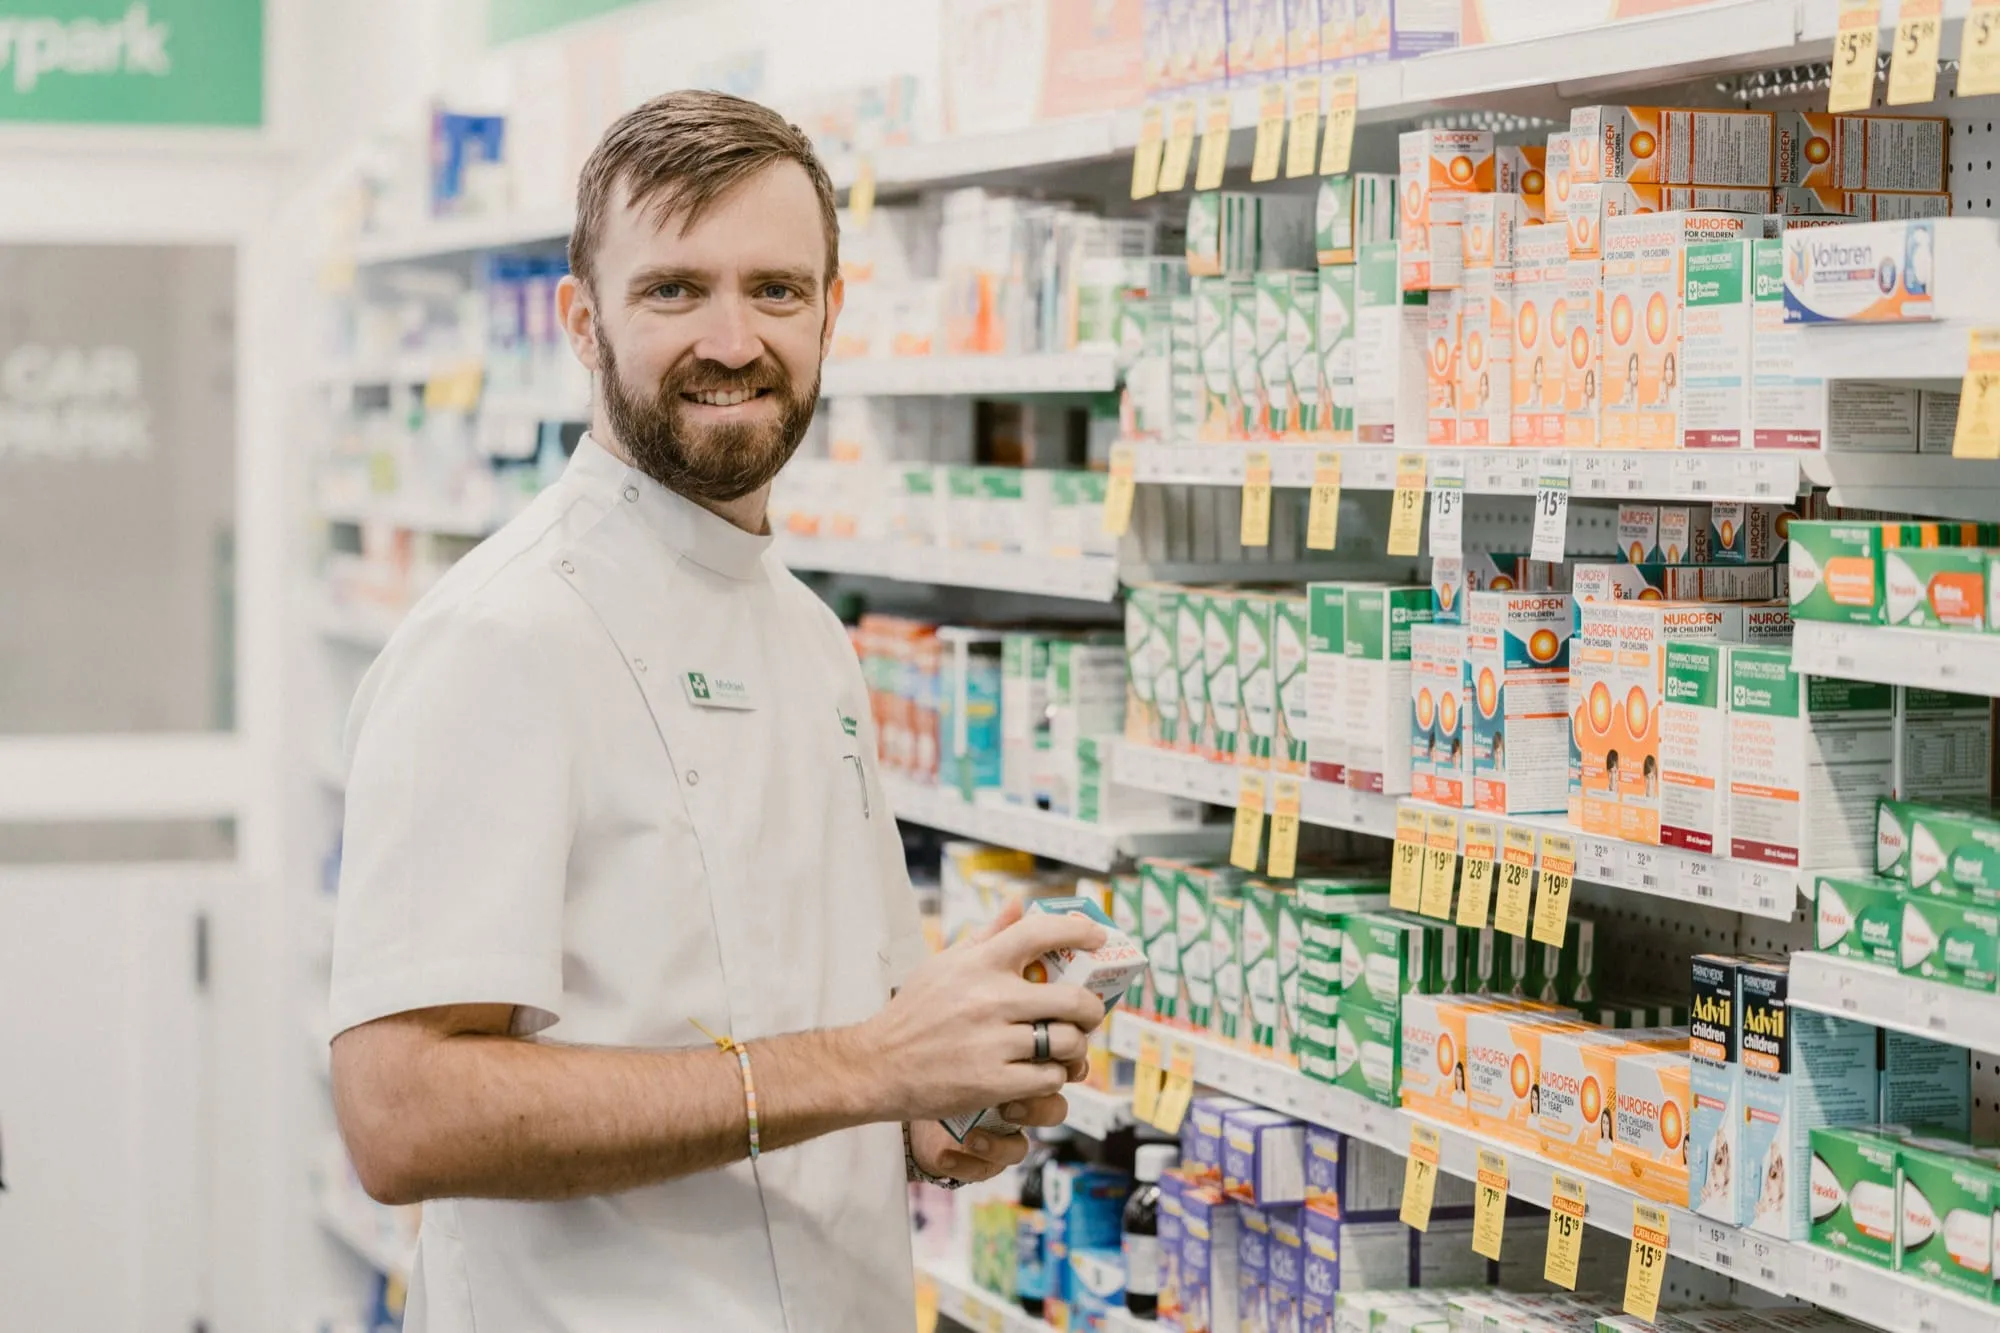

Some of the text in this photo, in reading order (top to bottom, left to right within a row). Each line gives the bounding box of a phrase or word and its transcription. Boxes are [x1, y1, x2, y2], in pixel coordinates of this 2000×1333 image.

[1433, 133, 1479, 144] NUROFEN
[1605, 125, 1615, 178] NUROFEN
[1781, 130, 1790, 183] NUROFEN
[1685, 218, 1743, 230] NUROFEN
[1701, 231, 1734, 239] CHILDREN
[1812, 242, 1872, 268] Voltaren
[1621, 511, 1654, 525] NUROFEN
[1751, 506, 1760, 559] NUROFEN
[1576, 569, 1606, 582] NUROFEN
[1508, 599, 1564, 611] NUROFEN
[1664, 612, 1723, 625] NUROFEN
[1584, 624, 1617, 638] NUROFEN
[1621, 625, 1654, 641] NUROFEN
[1680, 625, 1712, 633] CHILDREN
[1592, 639, 1611, 648] CHILDREN
[1629, 642, 1648, 652] CHILDREN
[1692, 993, 1731, 1027] Advil
[1744, 1004, 1784, 1039] Advil
[1692, 1022, 1726, 1043] children
[1744, 1033, 1780, 1056] children
[1472, 1046, 1510, 1068] NUROFEN
[1481, 1064, 1502, 1079] CHILDREN
[1541, 1071, 1580, 1096] NUROFEN
[1541, 1088, 1575, 1107] FOR CHILDREN
[1548, 1100, 1562, 1114] YEARS
[1618, 1094, 1659, 1121] NUROFEN
[1618, 1112, 1654, 1133] FOR CHILDREN
[1626, 1125, 1641, 1139] YEARS
[1555, 1197, 1583, 1217] CATALOGUE
[1636, 1226, 1665, 1248] CATALOGUE
